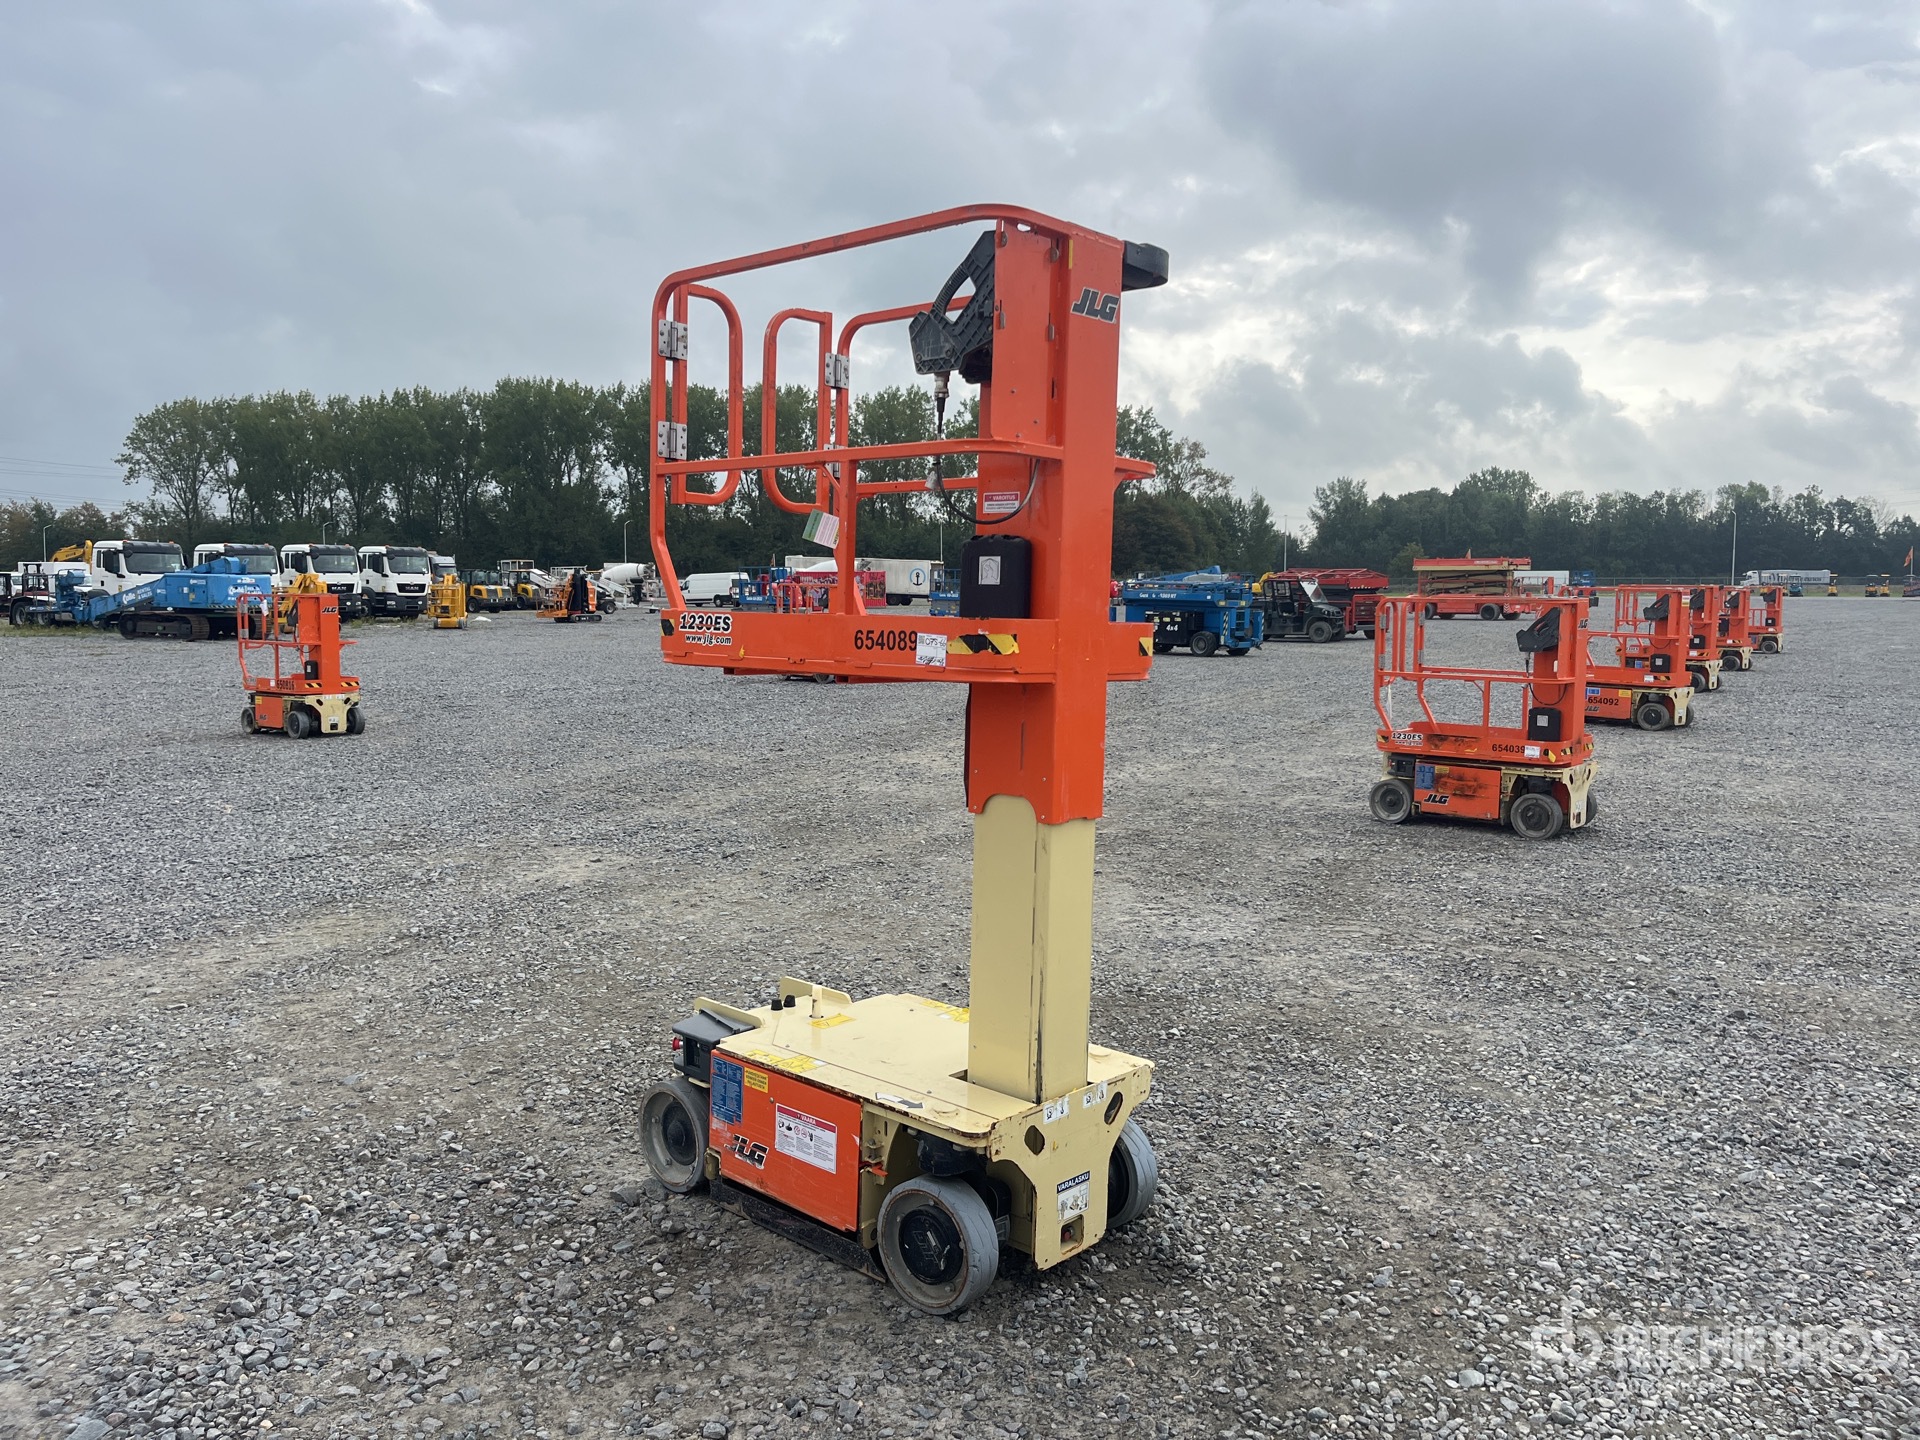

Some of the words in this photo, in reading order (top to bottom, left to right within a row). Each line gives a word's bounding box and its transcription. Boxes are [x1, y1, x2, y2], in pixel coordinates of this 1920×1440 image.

[1070, 287, 1120, 324] JLG
[679, 611, 733, 634] 1230ES
[1165, 624, 1179, 632] 4x4
[685, 633, 732, 646] www.jlg.com
[854, 629, 918, 651] 654089
[1587, 696, 1619, 706] 654092
[1391, 732, 1424, 741] 1230ES
[1491, 743, 1525, 754] 654039
[1423, 793, 1450, 805] JLG
[724, 1133, 769, 1170] JLG
[1057, 1172, 1089, 1191] VARALASKU
